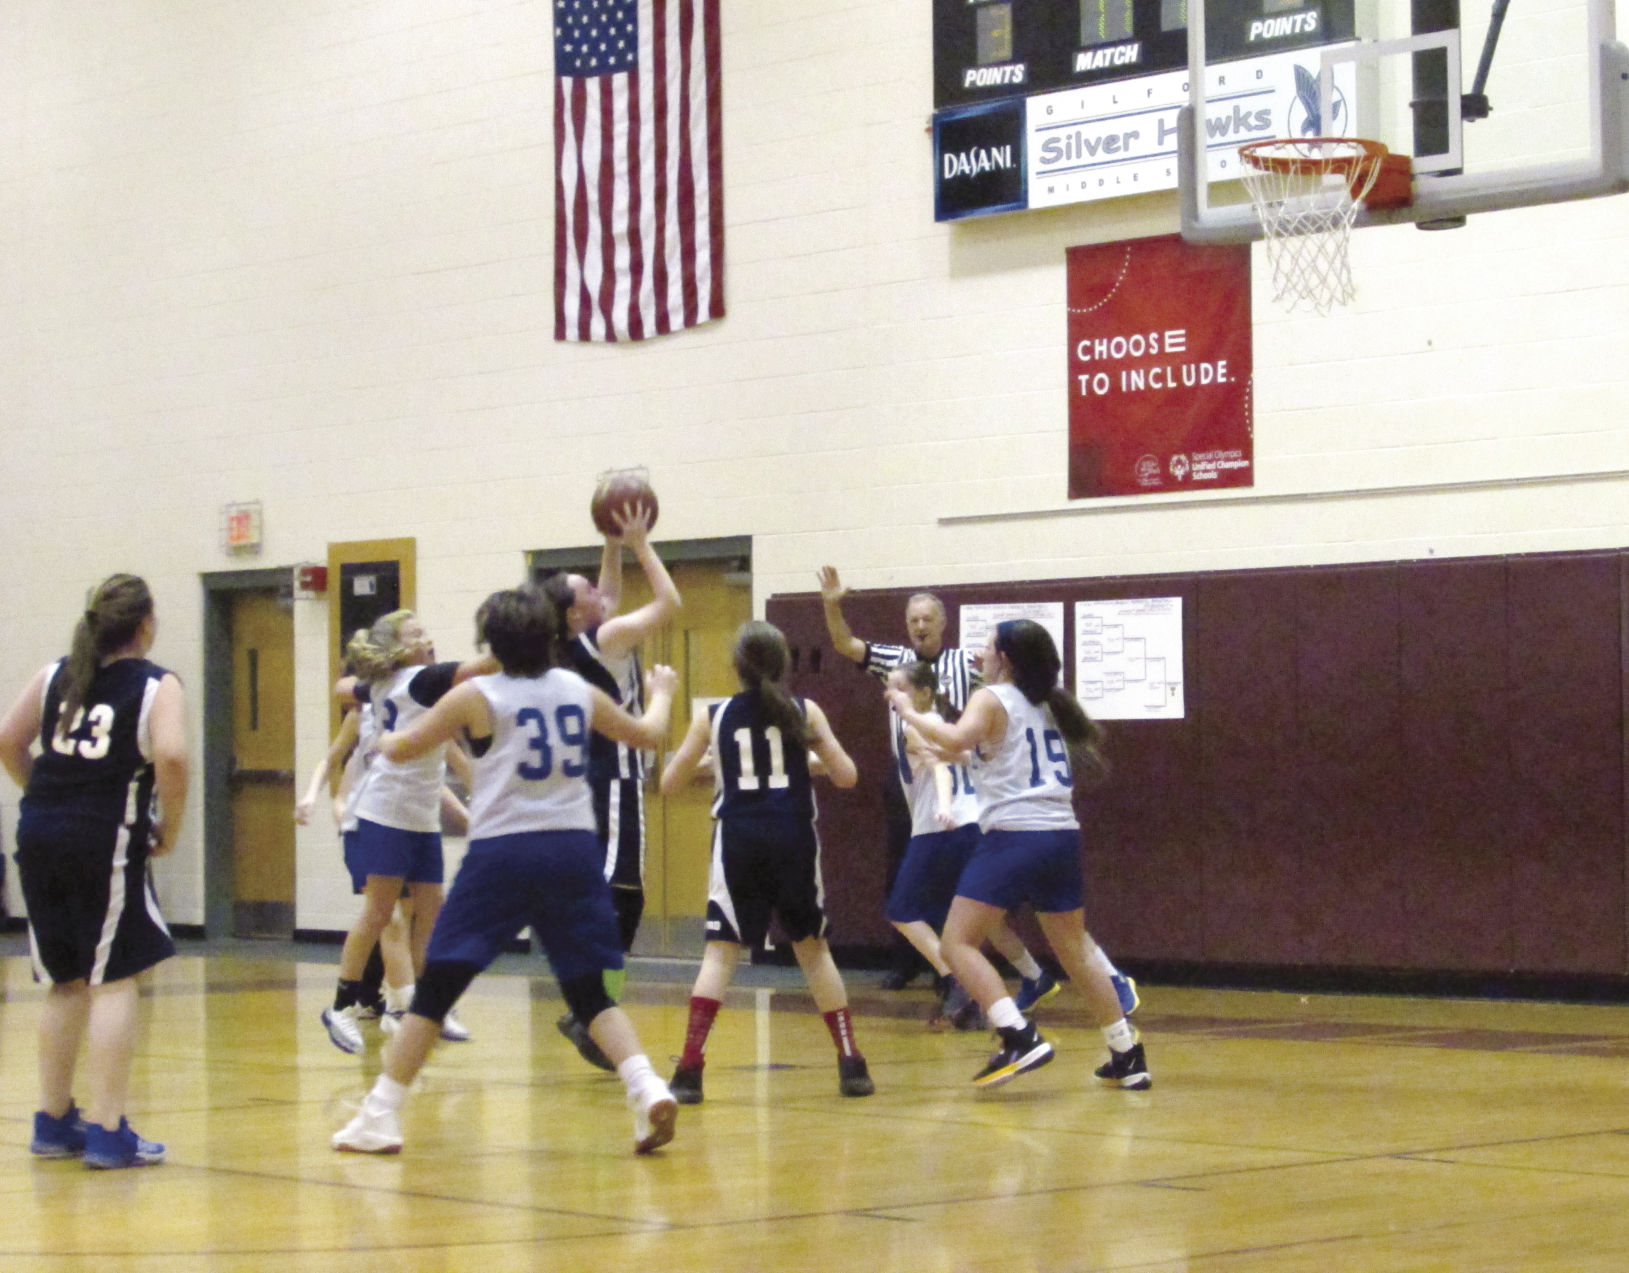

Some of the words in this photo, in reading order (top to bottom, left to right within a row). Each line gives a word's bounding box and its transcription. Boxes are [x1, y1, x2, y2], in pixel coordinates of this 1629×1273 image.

[1250, 11, 1318, 41] POINTS
[1076, 43, 1139, 72] MATCH
[964, 64, 1025, 88] POINTS
[1039, 129, 1140, 165] Silver
[1157, 104, 1272, 147] Hwks
[1046, 172, 1140, 195] MIDDLE
[1077, 329, 1186, 362] CHOOSE
[1078, 373, 1110, 396] TO
[1121, 360, 1236, 393] INCLUDE.
[515, 703, 587, 781] 39
[733, 725, 790, 791] 11
